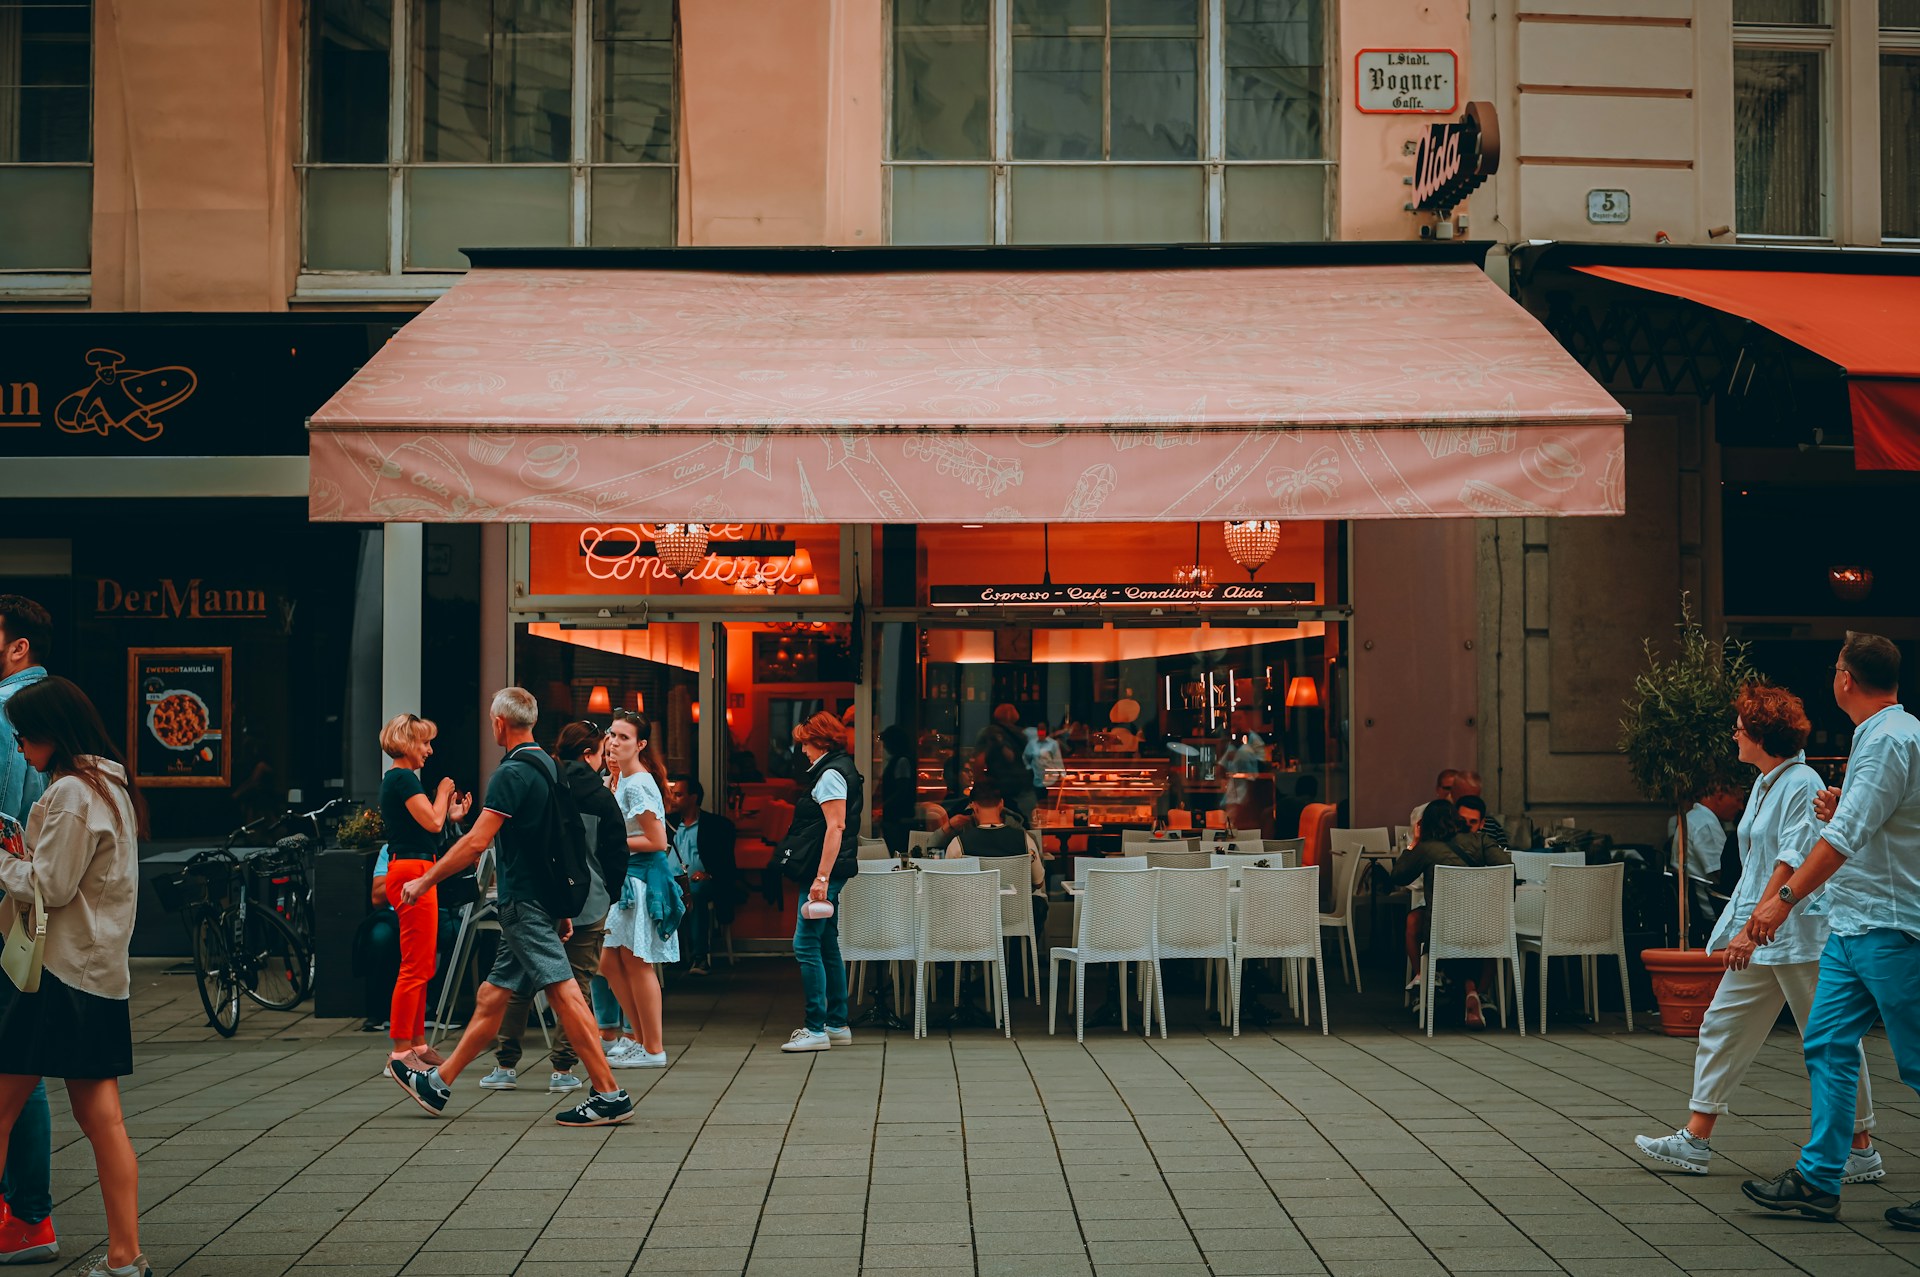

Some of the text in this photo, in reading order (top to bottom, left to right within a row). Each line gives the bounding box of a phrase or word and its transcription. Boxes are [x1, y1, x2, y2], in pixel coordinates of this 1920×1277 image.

[1602, 192, 1615, 211] 5
[673, 462, 706, 480] Aida
[1215, 463, 1242, 491] Aida
[596, 490, 629, 504] Aida
[981, 588, 1050, 600] Espresso
[1067, 587, 1107, 600] Café
[1125, 587, 1214, 599] Conditorei
